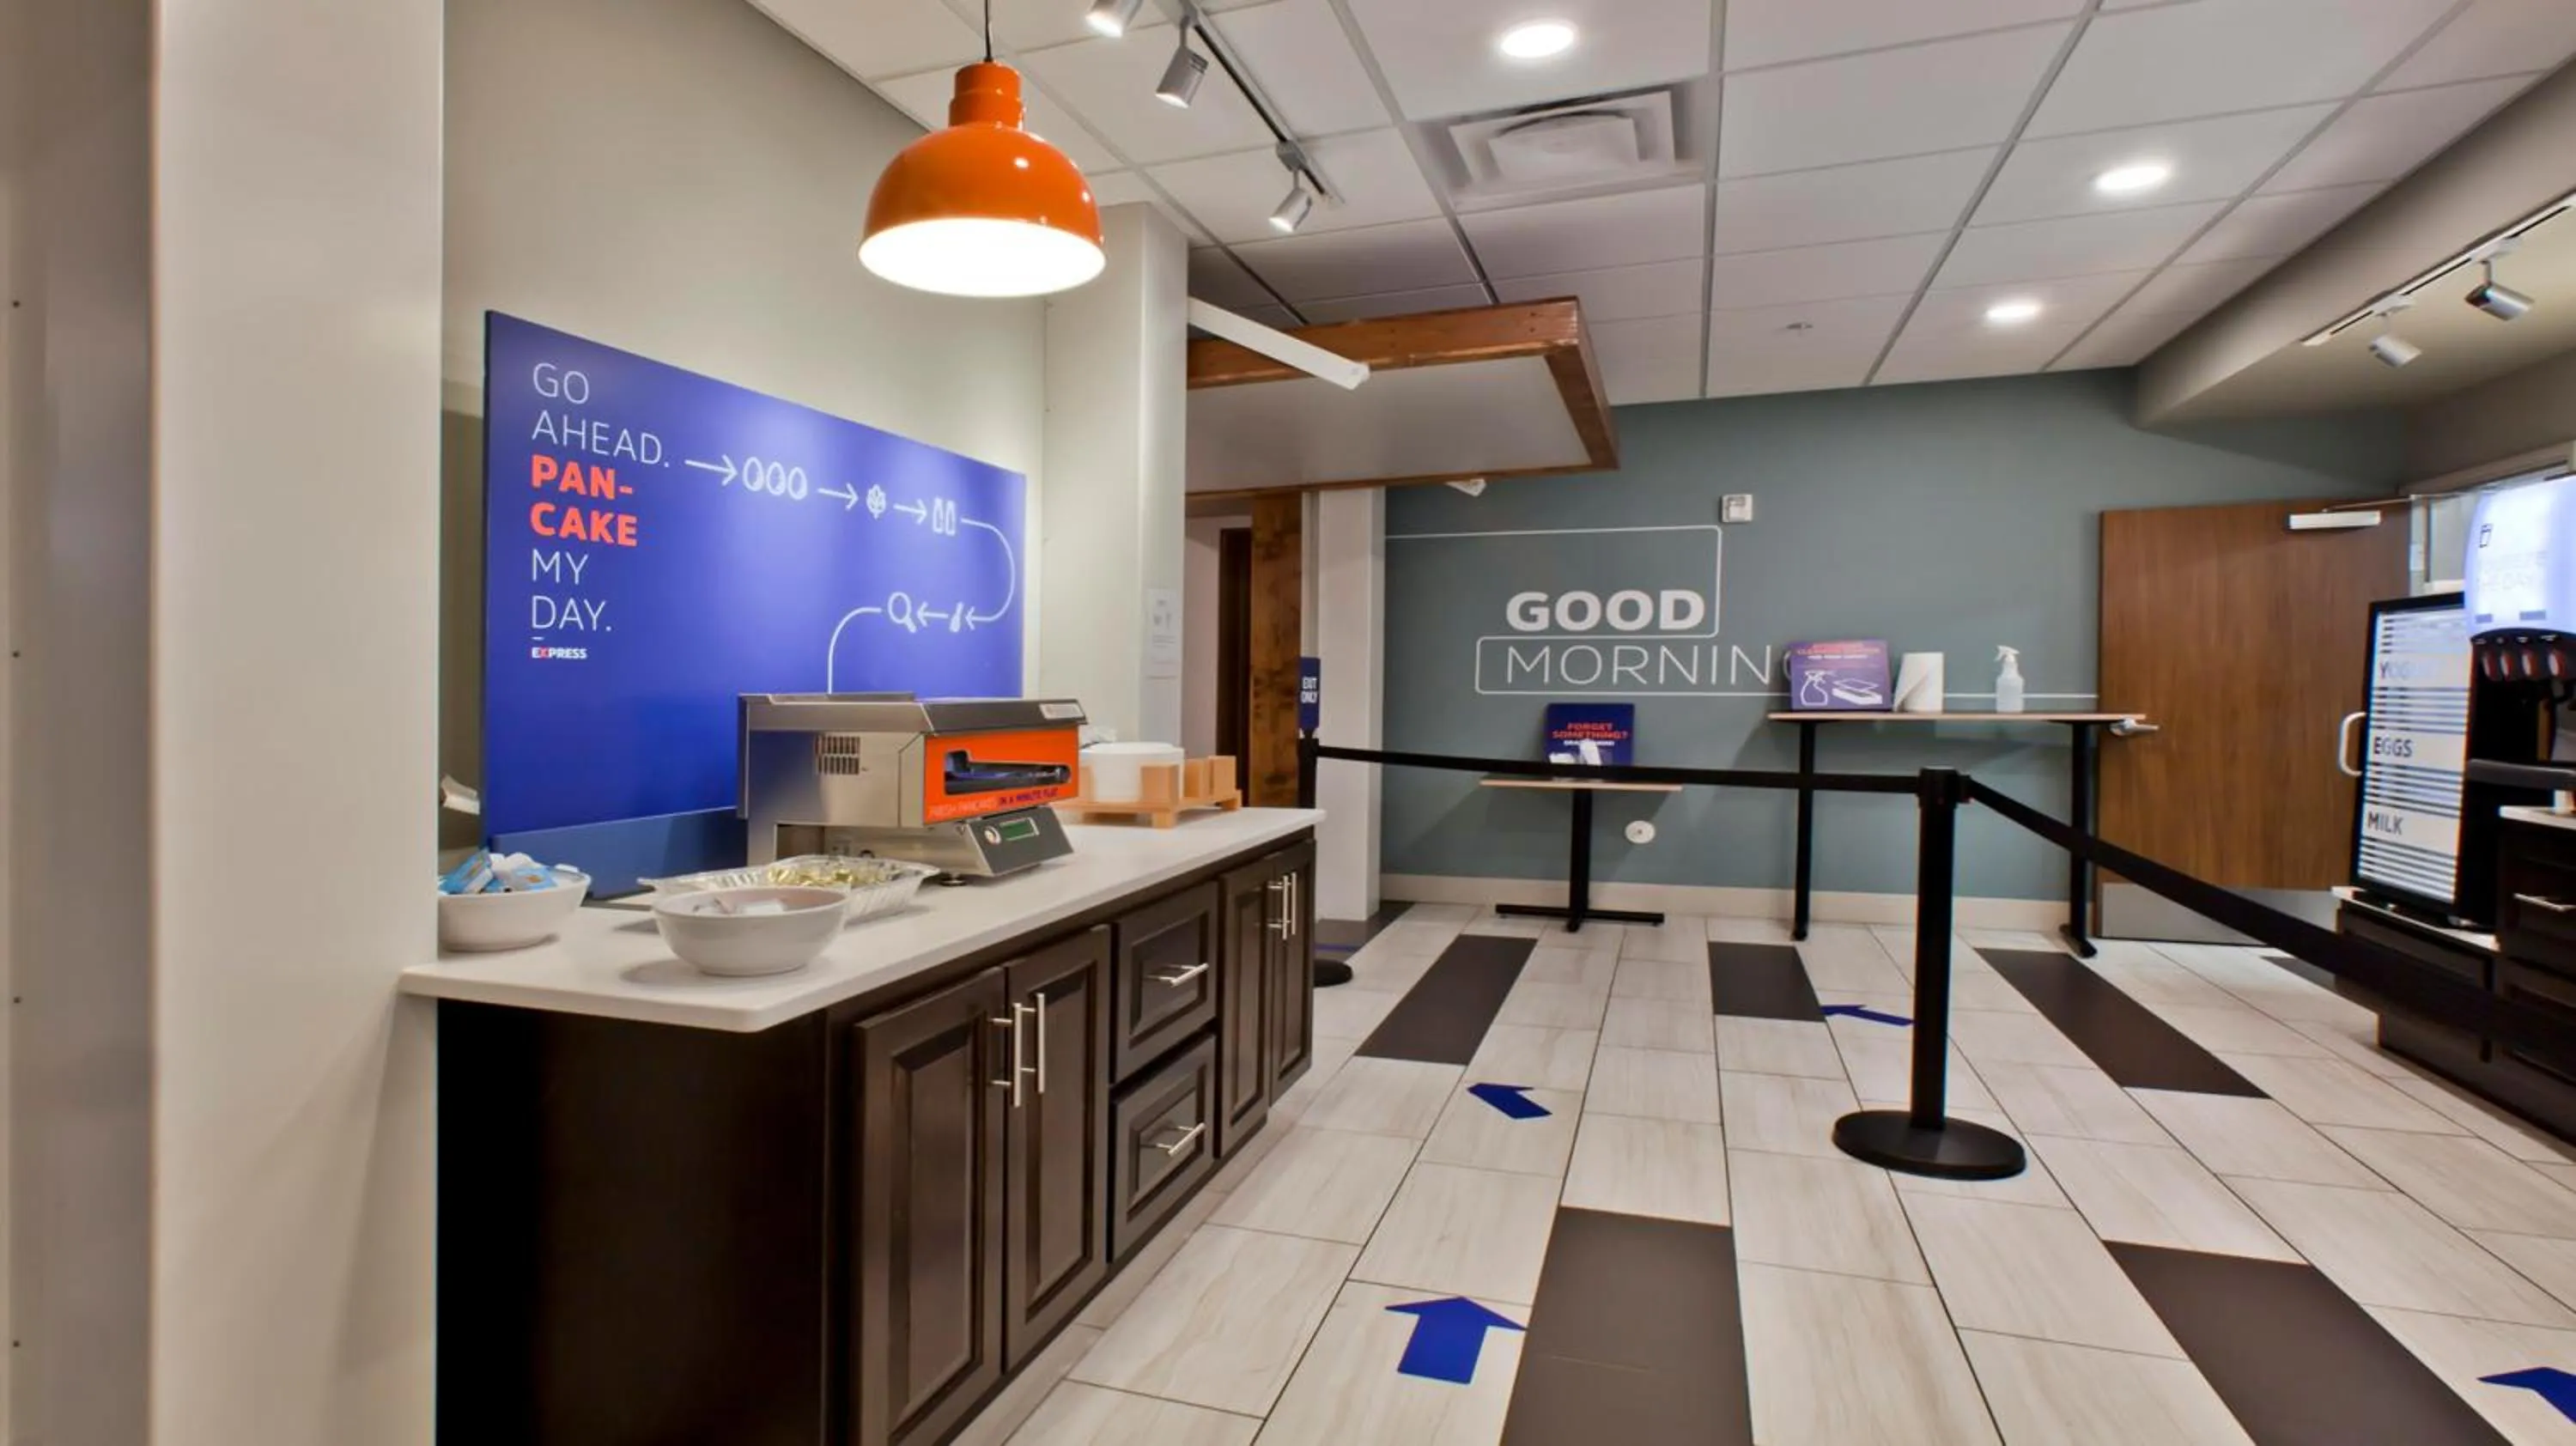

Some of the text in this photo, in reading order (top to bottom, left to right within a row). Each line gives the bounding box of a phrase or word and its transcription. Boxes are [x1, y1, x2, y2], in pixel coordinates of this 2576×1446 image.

[532, 362, 589, 404] GO
[532, 409, 670, 468] AHEAD.
[532, 453, 633, 499] PAN-
[530, 501, 638, 547] CAKE
[532, 548, 589, 585] MY
[532, 595, 612, 631] DAY.
[1506, 589, 1704, 631] GOOD
[532, 647, 587, 659] EXPRESS
[1507, 645, 1792, 685] MORNIN
[1301, 690, 1317, 703] ONLY
[1303, 677, 1317, 690] EXIT
[1567, 722, 1613, 731] FORGET
[2373, 737, 2412, 758] EGGS
[2367, 811, 2403, 835] MILK
